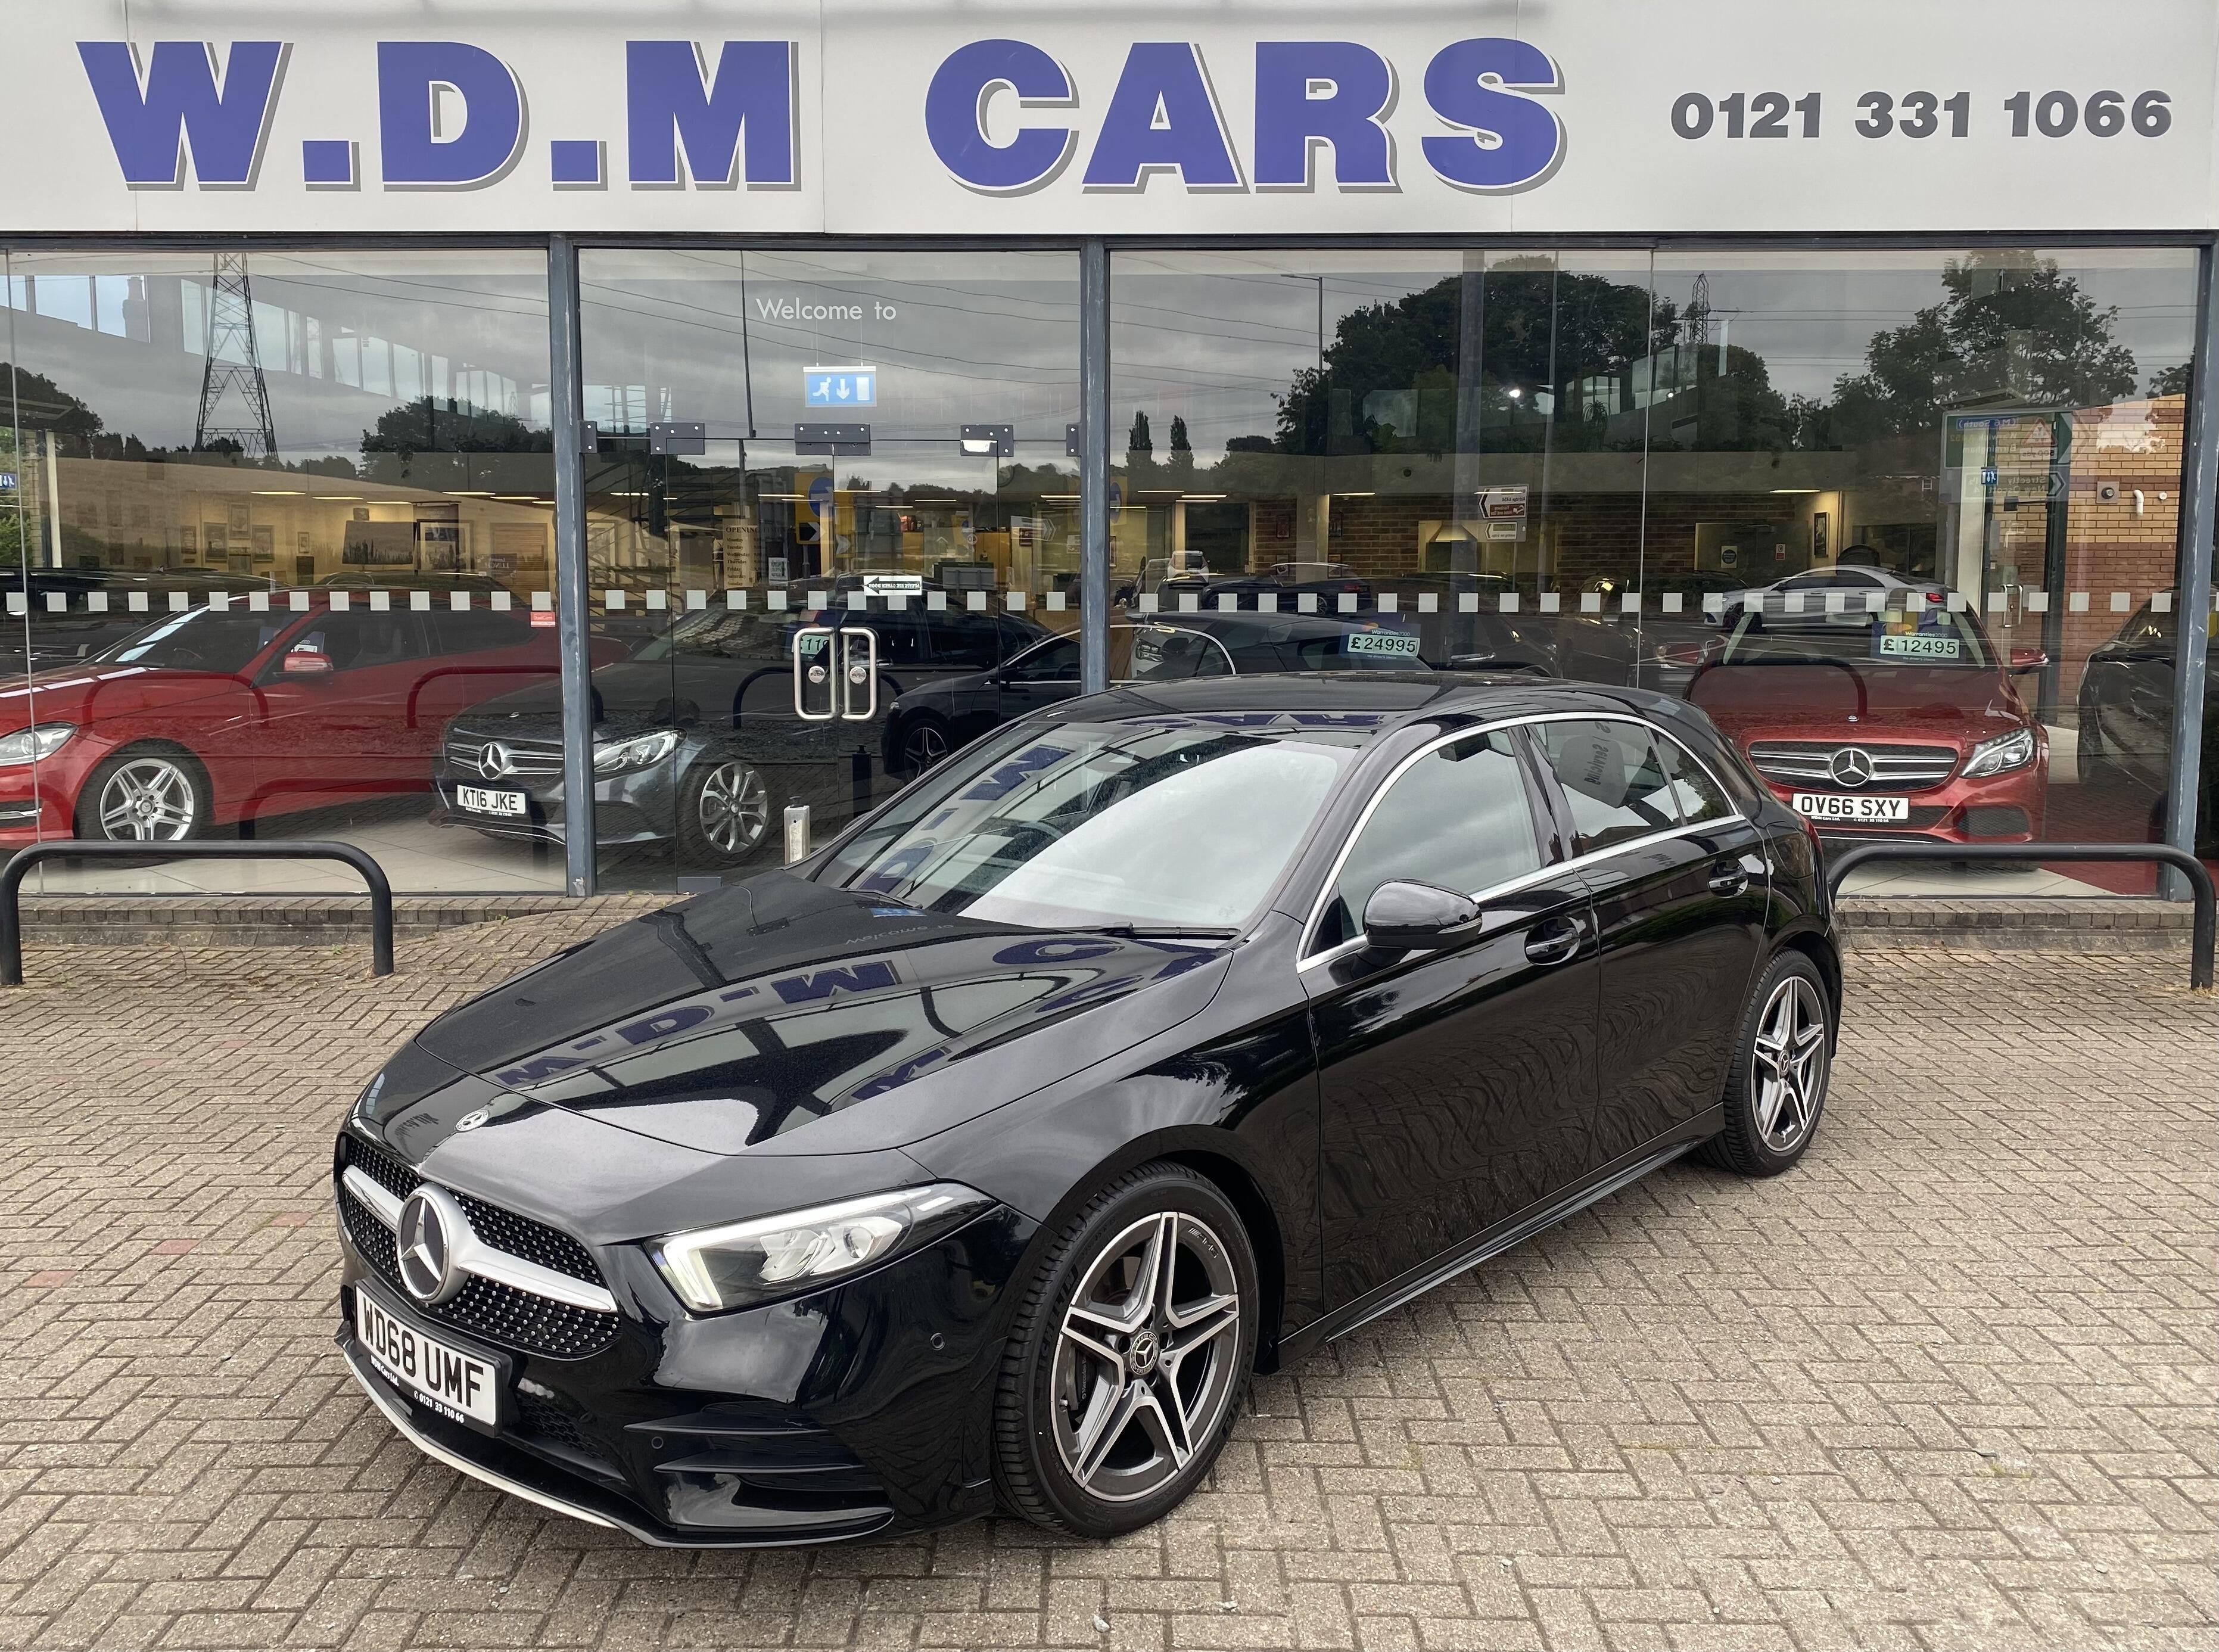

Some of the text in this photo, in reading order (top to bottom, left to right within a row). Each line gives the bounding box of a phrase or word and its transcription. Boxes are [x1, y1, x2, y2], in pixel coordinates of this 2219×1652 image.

[76, 38, 1568, 198] W.D.M CARS
[1670, 91, 2172, 139] 0121 331 1066
[755, 297, 897, 320] Welcome to
[1350, 637, 1416, 652] £24995
[1884, 638, 1956, 654] £12495
[463, 788, 518, 811] KT16 JKE
[1801, 796, 1900, 817] OV66 SXY
[363, 1296, 484, 1408] WD68 UMF
[381, 1365, 390, 1380] Cars
[419, 1392, 432, 1408] 0121
[434, 1401, 443, 1414] 33
